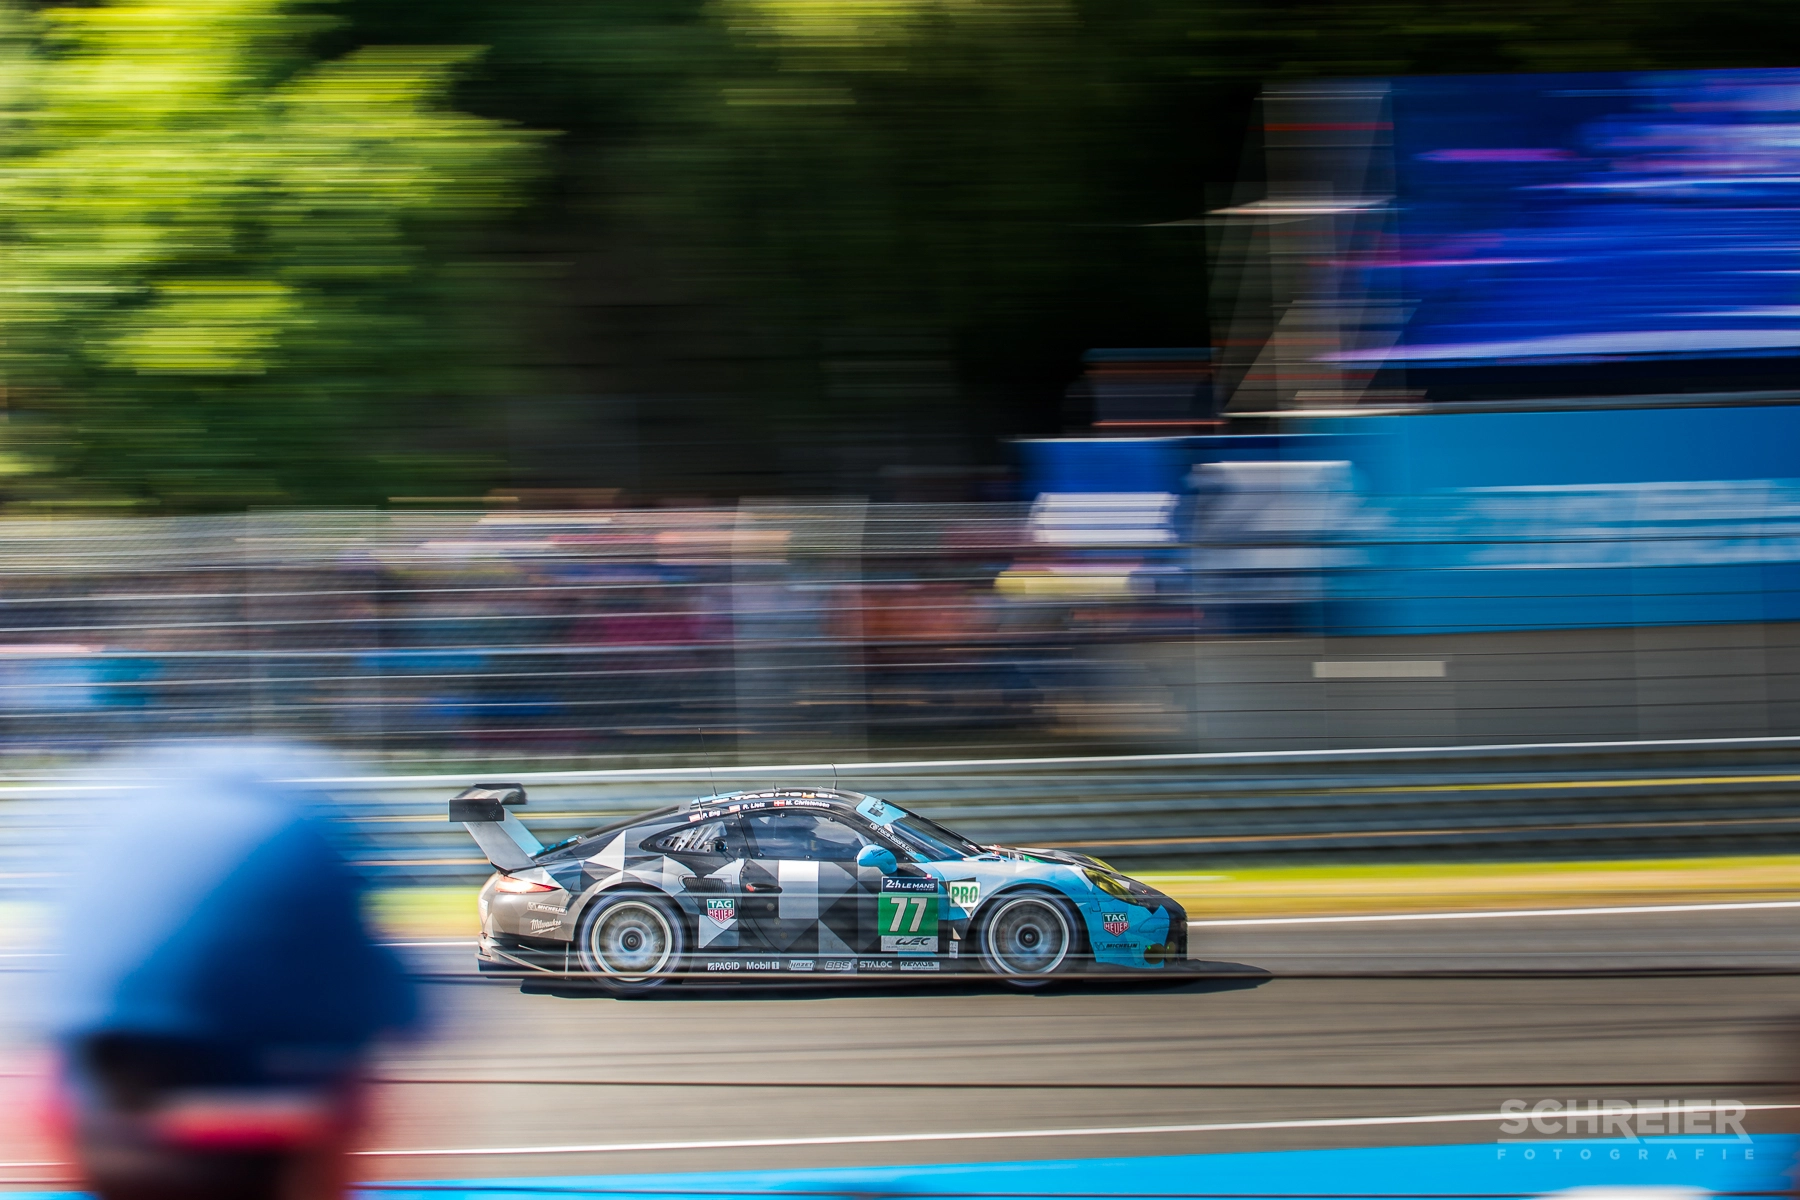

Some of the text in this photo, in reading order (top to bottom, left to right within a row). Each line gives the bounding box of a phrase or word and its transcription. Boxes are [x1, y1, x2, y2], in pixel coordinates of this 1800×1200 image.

[951, 885, 979, 904] PRO
[537, 904, 566, 913] MICHELIN
[710, 900, 732, 909] TAG
[709, 909, 734, 922] HEUER
[889, 896, 928, 932] 77
[1104, 914, 1126, 922] TAG
[1104, 921, 1129, 935] HEUER
[895, 937, 931, 946] WEC
[715, 962, 740, 971] PAGID
[746, 961, 771, 970] Mobil
[825, 961, 849, 970] BBS
